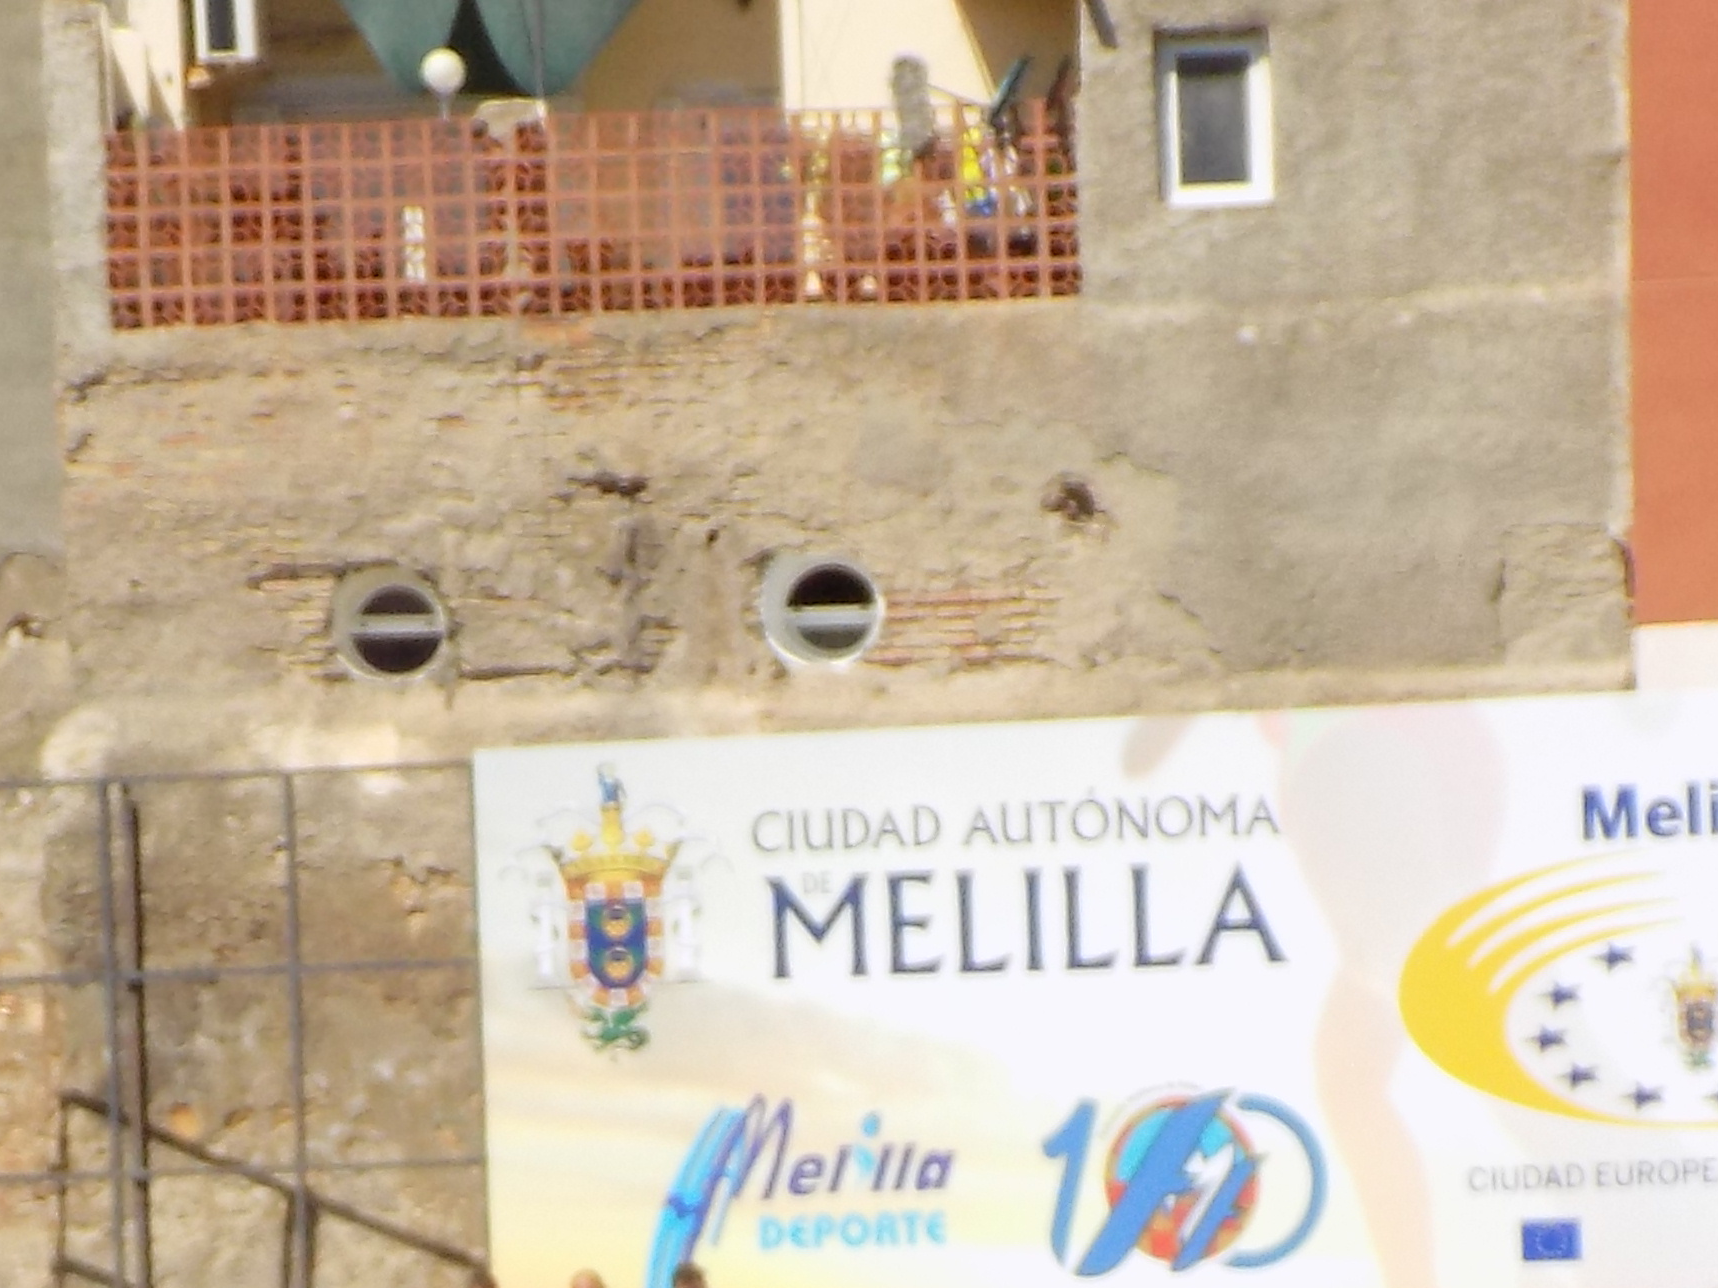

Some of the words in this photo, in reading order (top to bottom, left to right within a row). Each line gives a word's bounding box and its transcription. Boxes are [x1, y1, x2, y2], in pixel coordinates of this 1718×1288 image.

[752, 806, 942, 853] CIUDAD
[963, 788, 1281, 845] AUTÓNOMA
[765, 862, 1289, 979] MELILLA
[687, 1093, 955, 1225] Melilla
[1467, 1163, 1584, 1193] CIUDAD
[758, 1210, 947, 1250] DEPORTE
